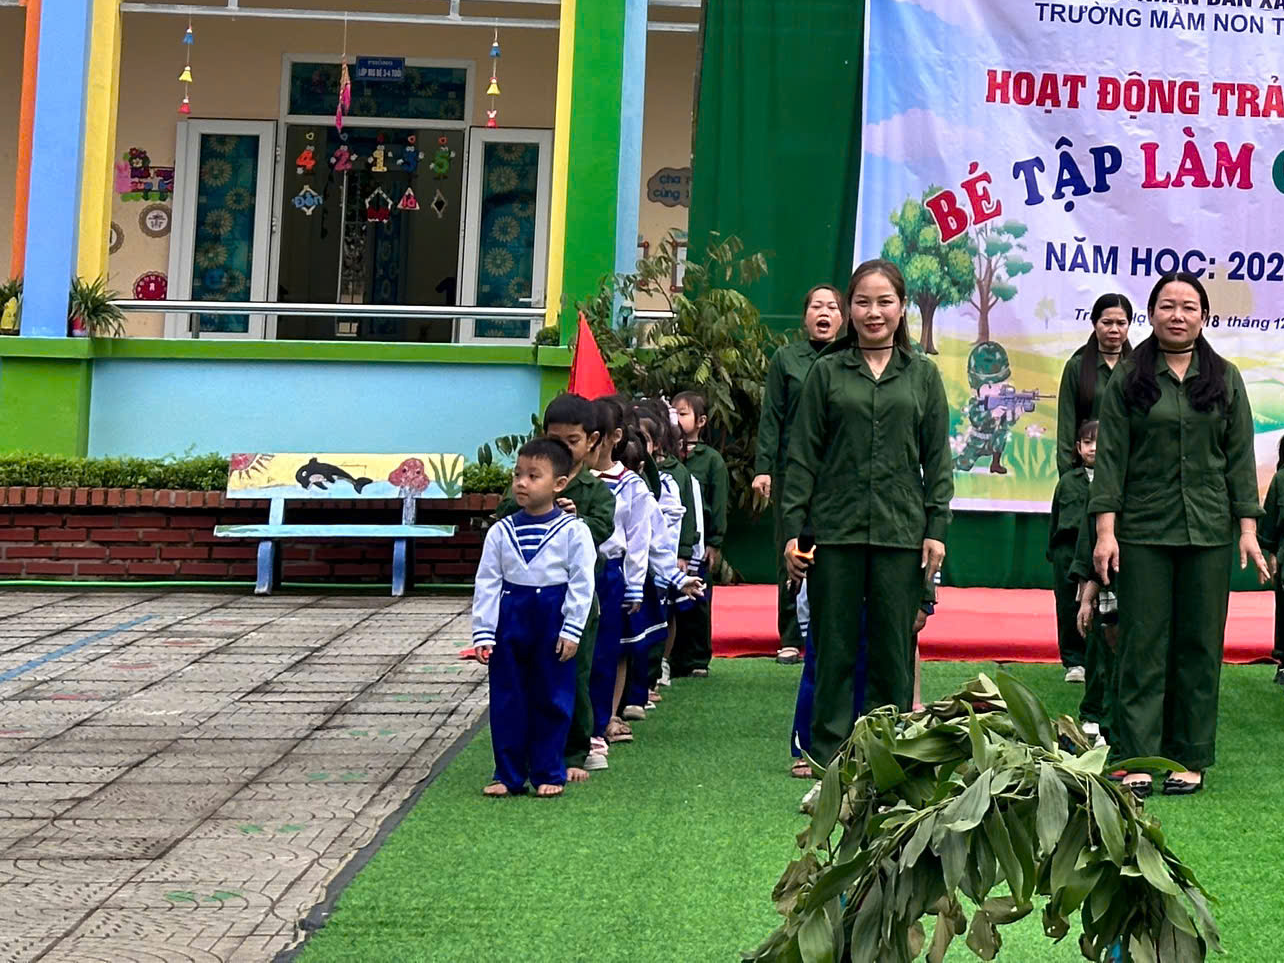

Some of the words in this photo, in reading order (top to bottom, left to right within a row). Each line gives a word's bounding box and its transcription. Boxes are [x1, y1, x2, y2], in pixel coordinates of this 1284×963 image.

[1034, 0, 1142, 28] TRƯỜNG
[1213, 13, 1264, 35] NON
[985, 68, 1087, 114] HOẠT
[1096, 70, 1201, 120] ĐỘNG
[925, 161, 1002, 243] BÉ
[1012, 136, 1123, 213] TẬP
[1140, 126, 1255, 190] LÀM
[1045, 236, 1119, 277] NĂM
[1227, 316, 1271, 331] tháng
